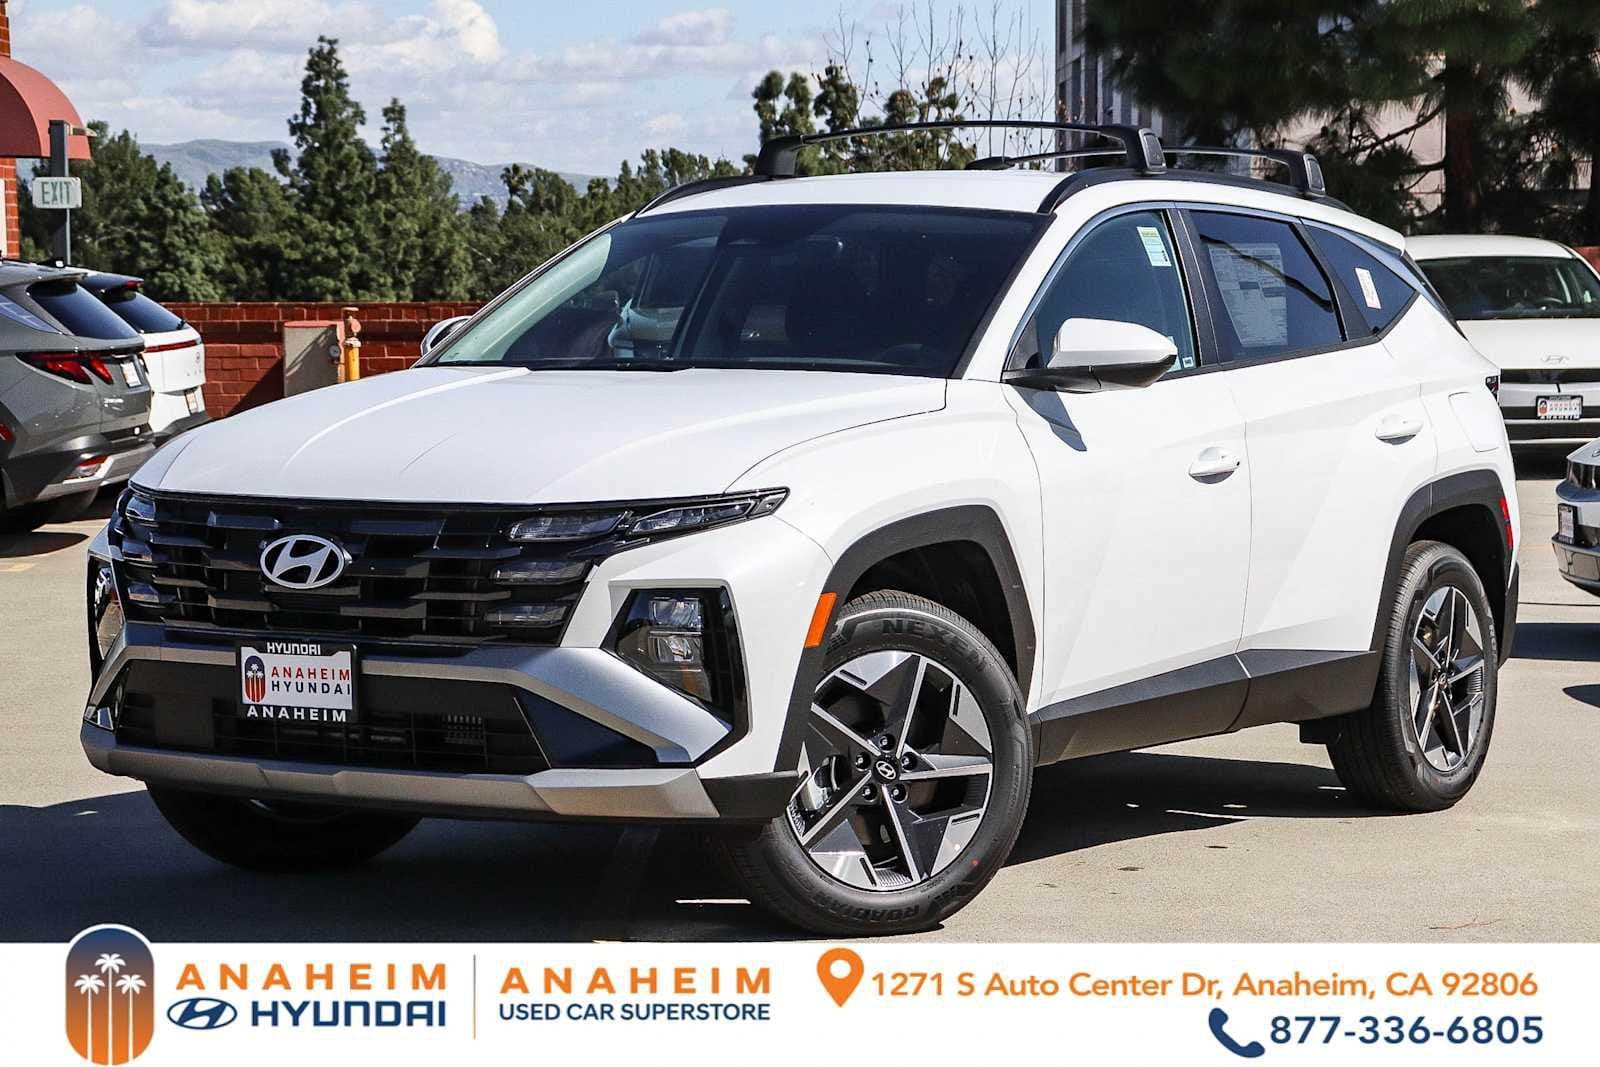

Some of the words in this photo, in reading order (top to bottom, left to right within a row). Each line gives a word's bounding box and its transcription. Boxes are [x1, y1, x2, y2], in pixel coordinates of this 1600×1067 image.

[41, 181, 71, 204] EXIT
[266, 642, 321, 655] HYUNDAI
[271, 666, 350, 681] ANAHEIM
[271, 681, 351, 695] HYUNDAI
[247, 705, 346, 722] ANAHEIM
